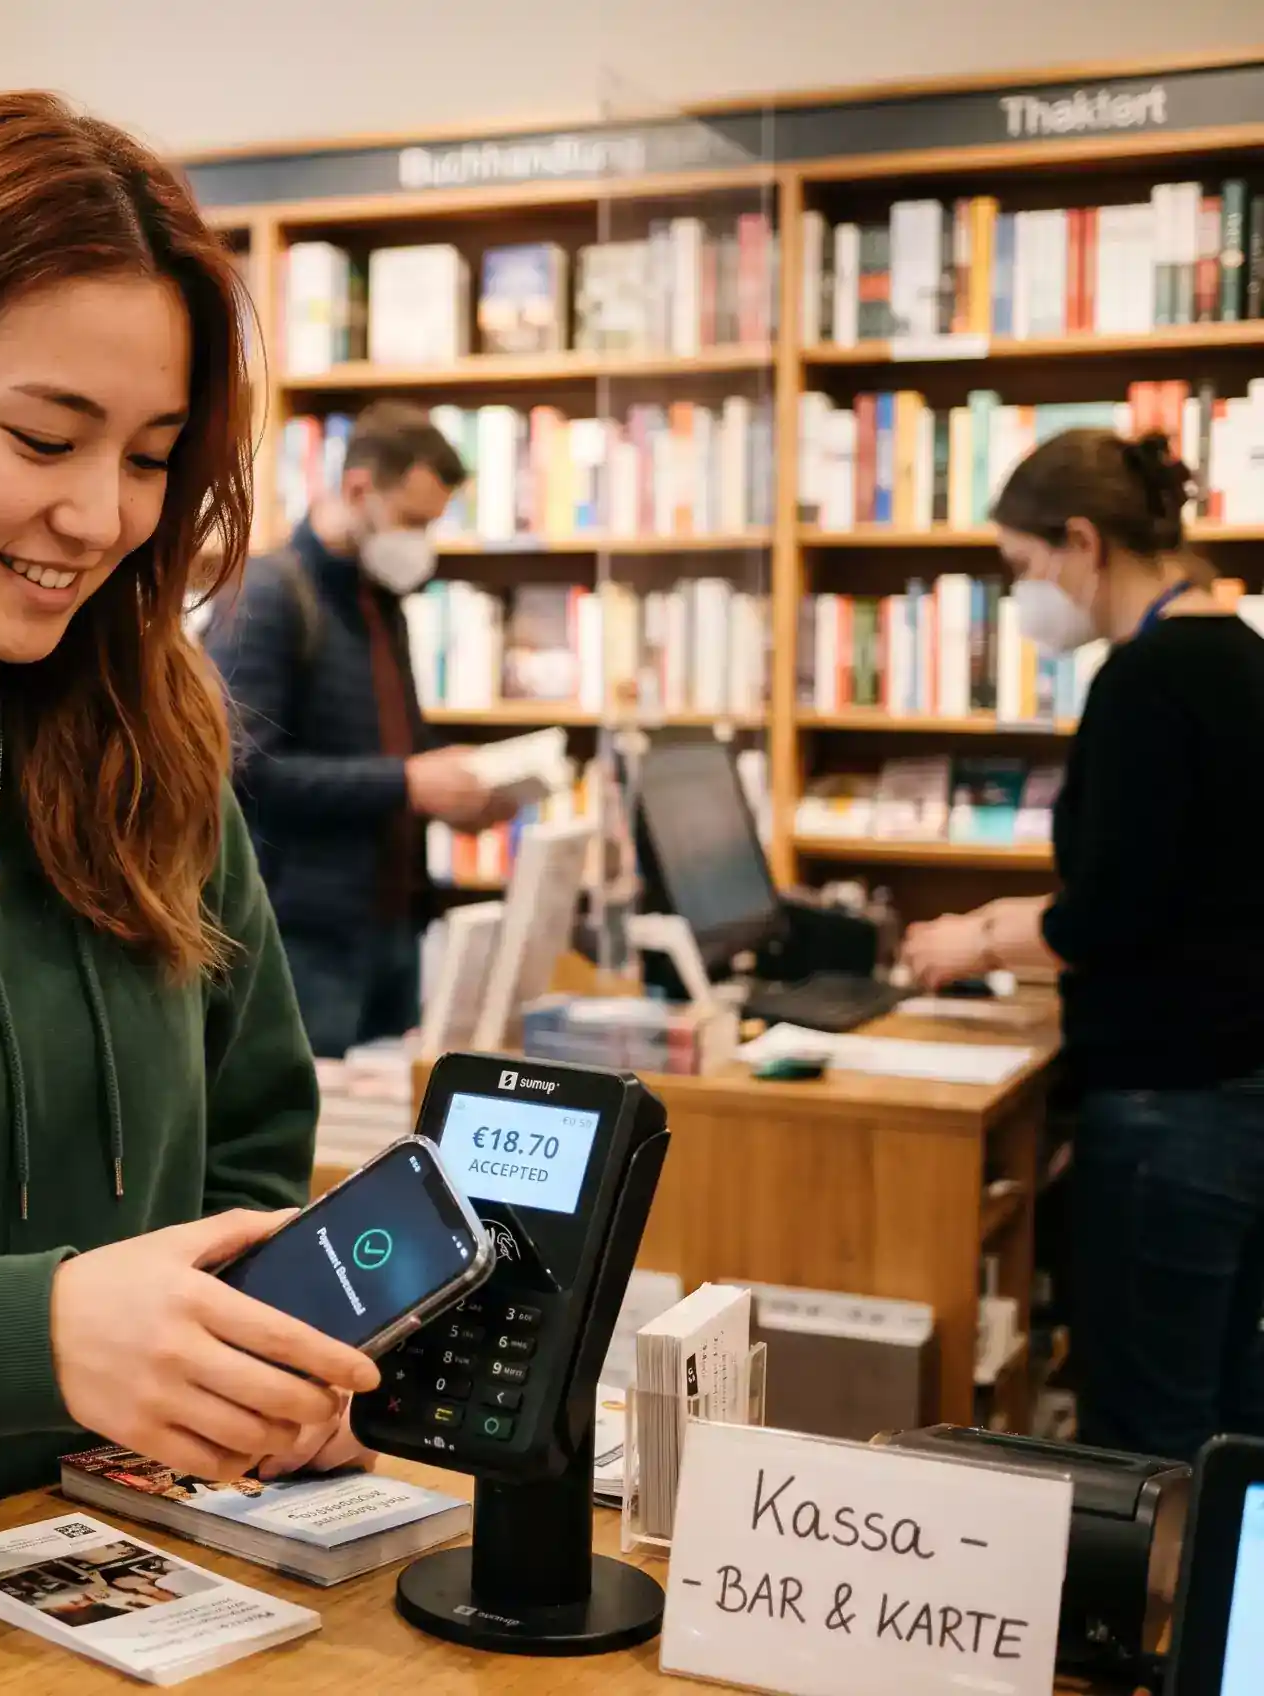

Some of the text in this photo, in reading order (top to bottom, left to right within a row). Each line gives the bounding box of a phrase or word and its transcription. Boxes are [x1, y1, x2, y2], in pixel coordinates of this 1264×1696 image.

[519, 1077, 556, 1095] sumup
[472, 1126, 560, 1159] €18.70
[468, 1158, 549, 1183] ACCEPTED
[505, 1307, 516, 1321] 3
[449, 1324, 459, 1338] 5
[498, 1335, 509, 1349] 6
[442, 1350, 453, 1364] 8
[492, 1361, 503, 1375] 9
[435, 1377, 446, 1391] 0
[751, 1467, 936, 1560] Kassa
[714, 1564, 807, 1625] BAR
[824, 1581, 854, 1635] &
[876, 1592, 1029, 1660] KARTE
